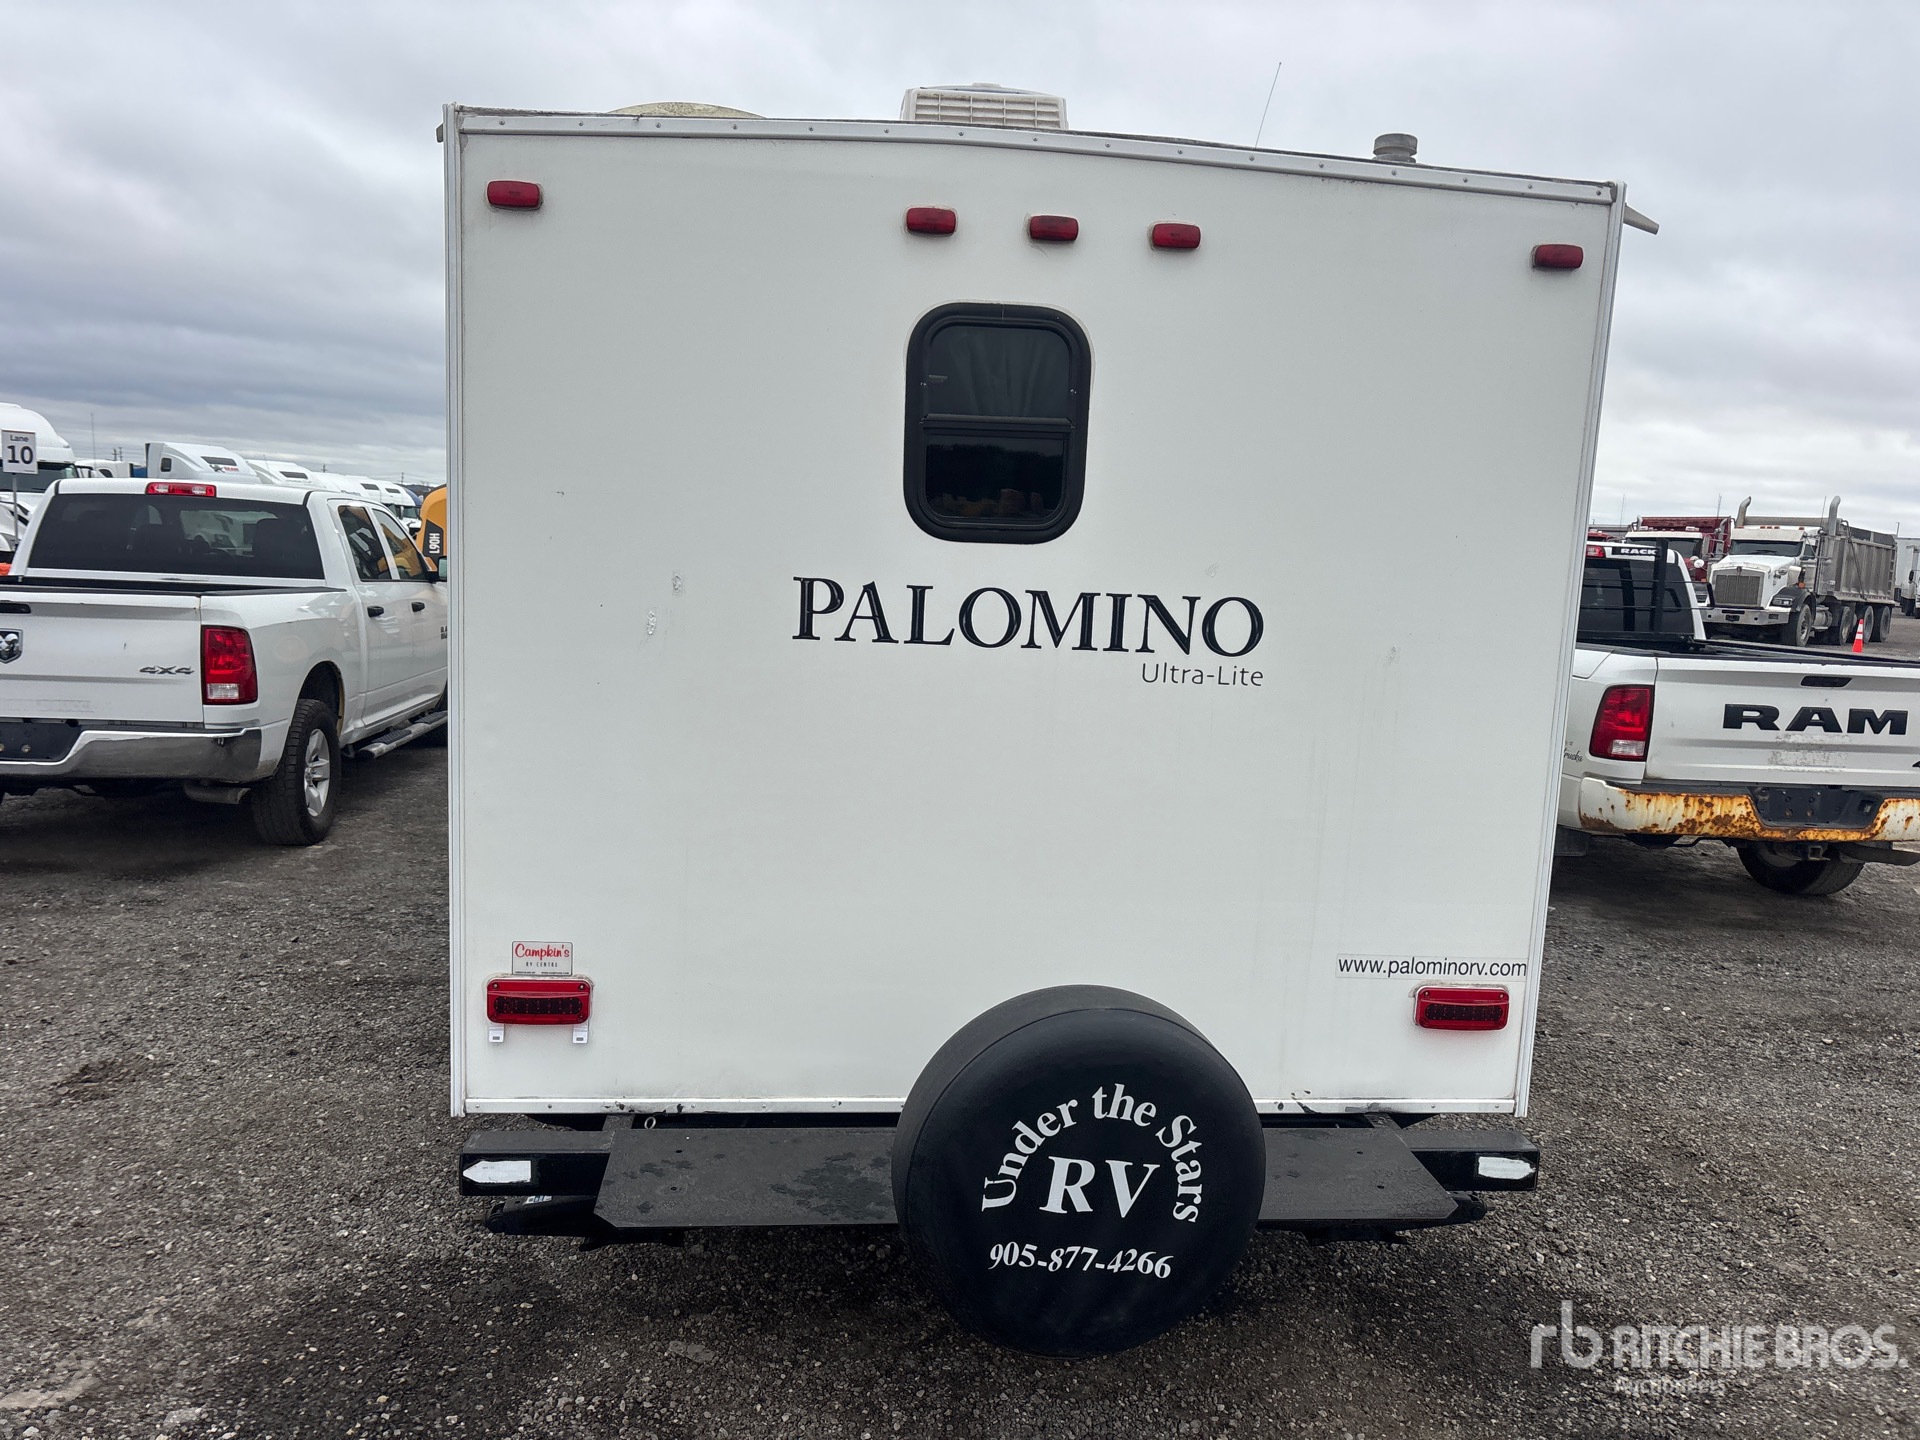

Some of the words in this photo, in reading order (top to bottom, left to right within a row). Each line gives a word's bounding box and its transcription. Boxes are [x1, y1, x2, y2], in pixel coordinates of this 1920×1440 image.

[10, 434, 29, 442] Lane
[7, 445, 33, 464] 10
[429, 533, 440, 554] L90H
[792, 576, 1264, 657] PALOMINO
[1141, 662, 1264, 687] Ultra-Lite
[1722, 703, 1908, 736] RAM
[515, 943, 570, 961] Campkin's
[1338, 957, 1527, 977] www.palominorv.com
[981, 1099, 1079, 1212] Under
[1091, 1083, 1157, 1127] the
[1155, 1114, 1203, 1223] Stars
[1039, 1155, 1161, 1219] RV
[988, 1241, 1175, 1279] 905-877-4266
